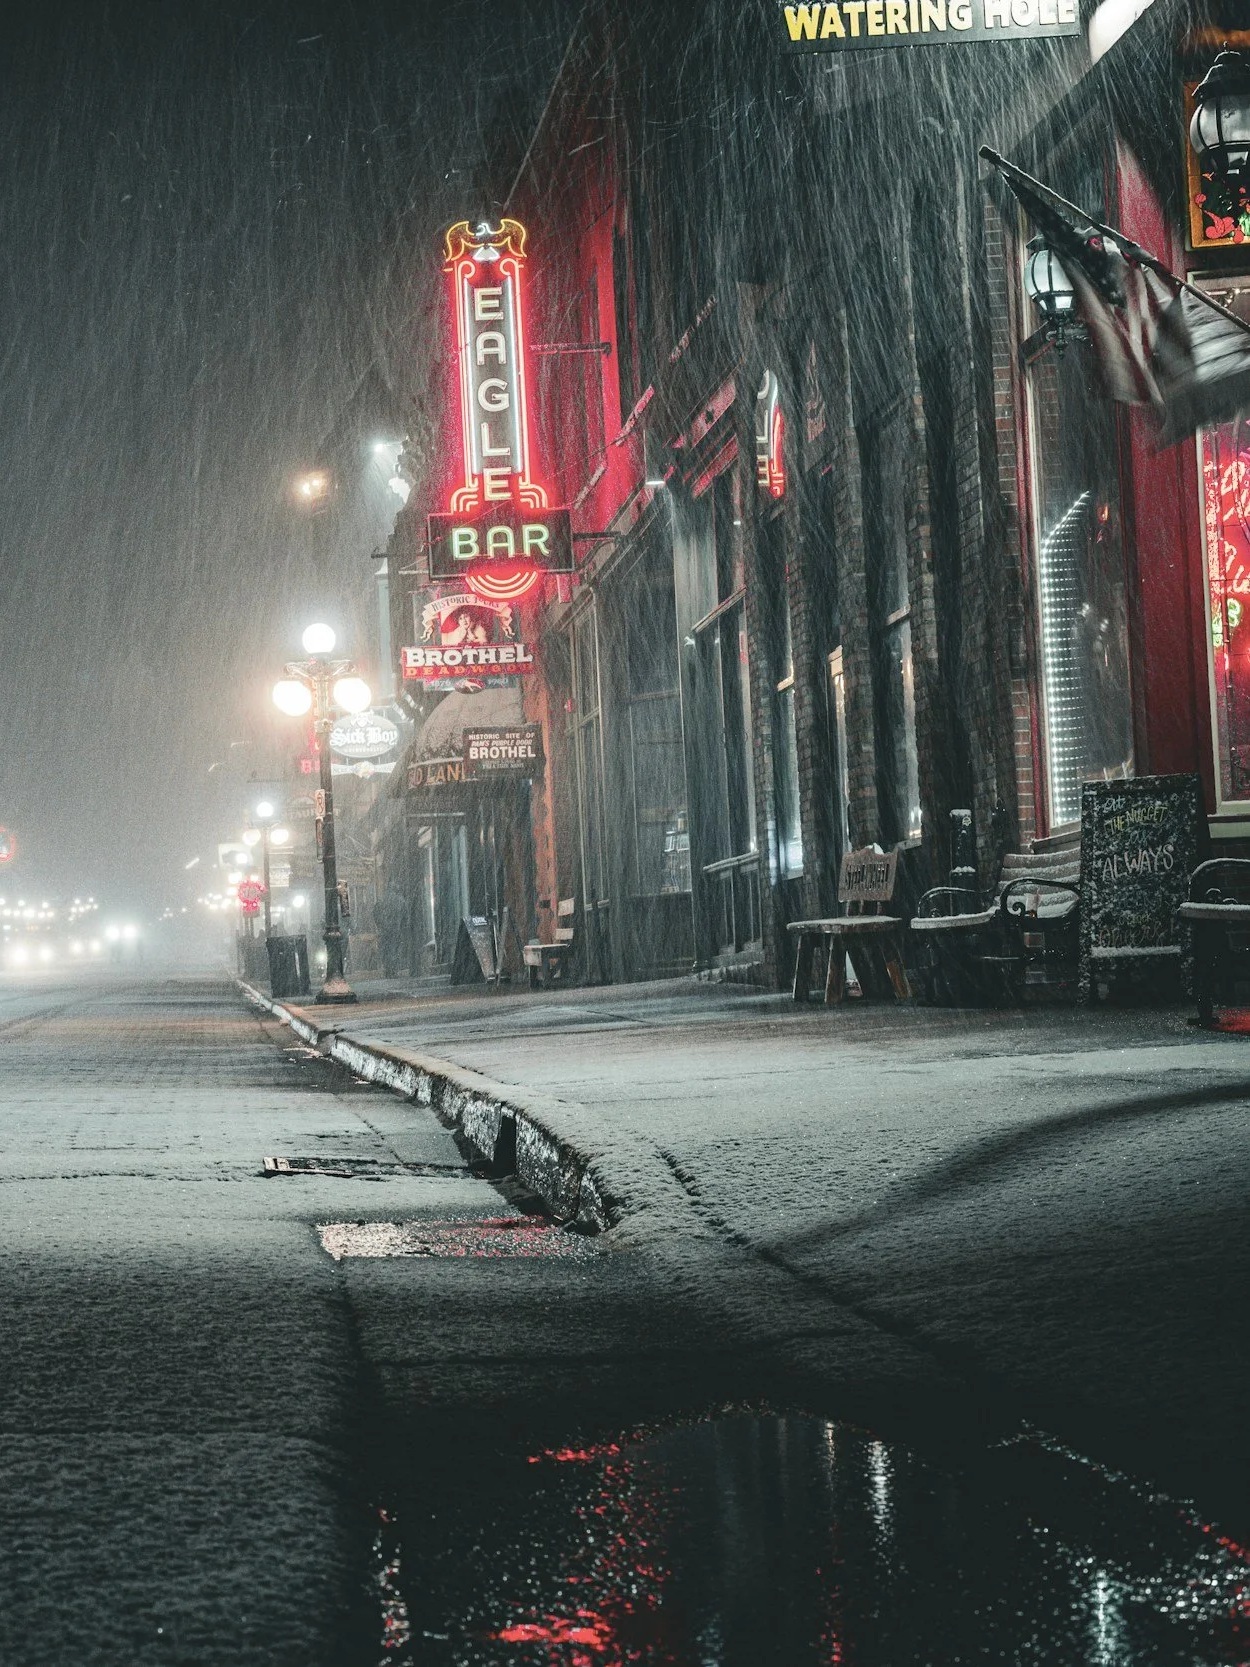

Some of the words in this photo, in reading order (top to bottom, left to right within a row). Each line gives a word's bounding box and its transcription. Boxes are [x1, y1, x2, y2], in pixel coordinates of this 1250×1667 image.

[784, 0, 973, 41] WATERING
[984, 0, 1075, 29] HOLE
[473, 286, 513, 501] EAGLE
[452, 523, 550, 561] BAR
[405, 643, 533, 667] BROTHEL
[469, 745, 536, 760] BROTHEL
[1102, 844, 1174, 882] ALWAYS
